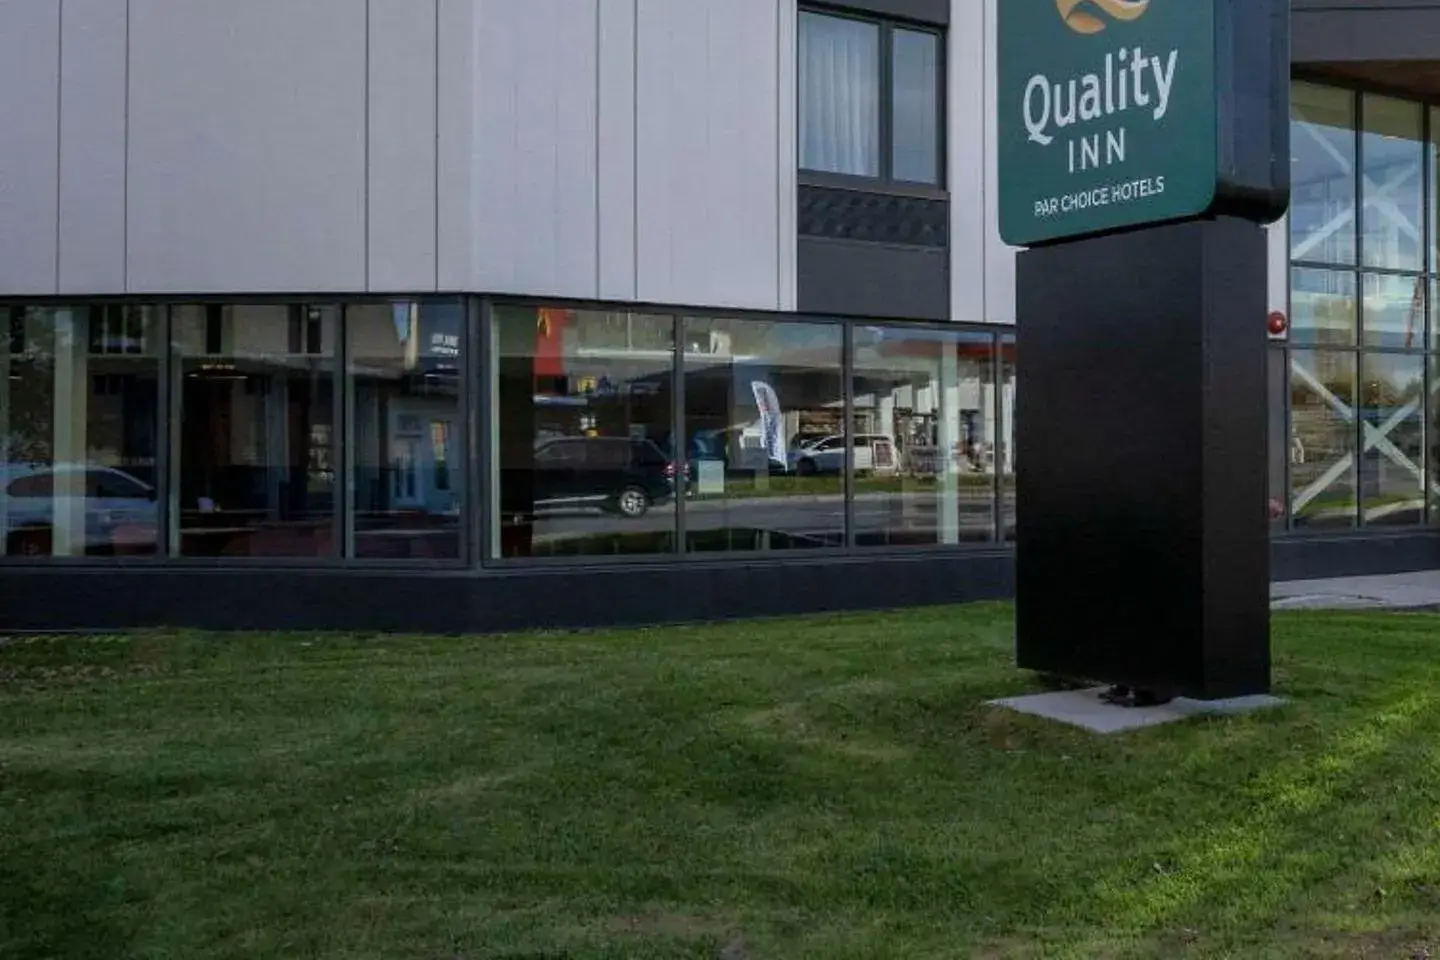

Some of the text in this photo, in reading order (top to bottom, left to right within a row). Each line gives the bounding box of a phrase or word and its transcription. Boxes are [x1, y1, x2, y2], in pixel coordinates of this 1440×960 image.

[1023, 46, 1178, 146] Quality
[1068, 127, 1126, 173] INN
[1033, 176, 1165, 217] PAR CHOICE HOTELS
